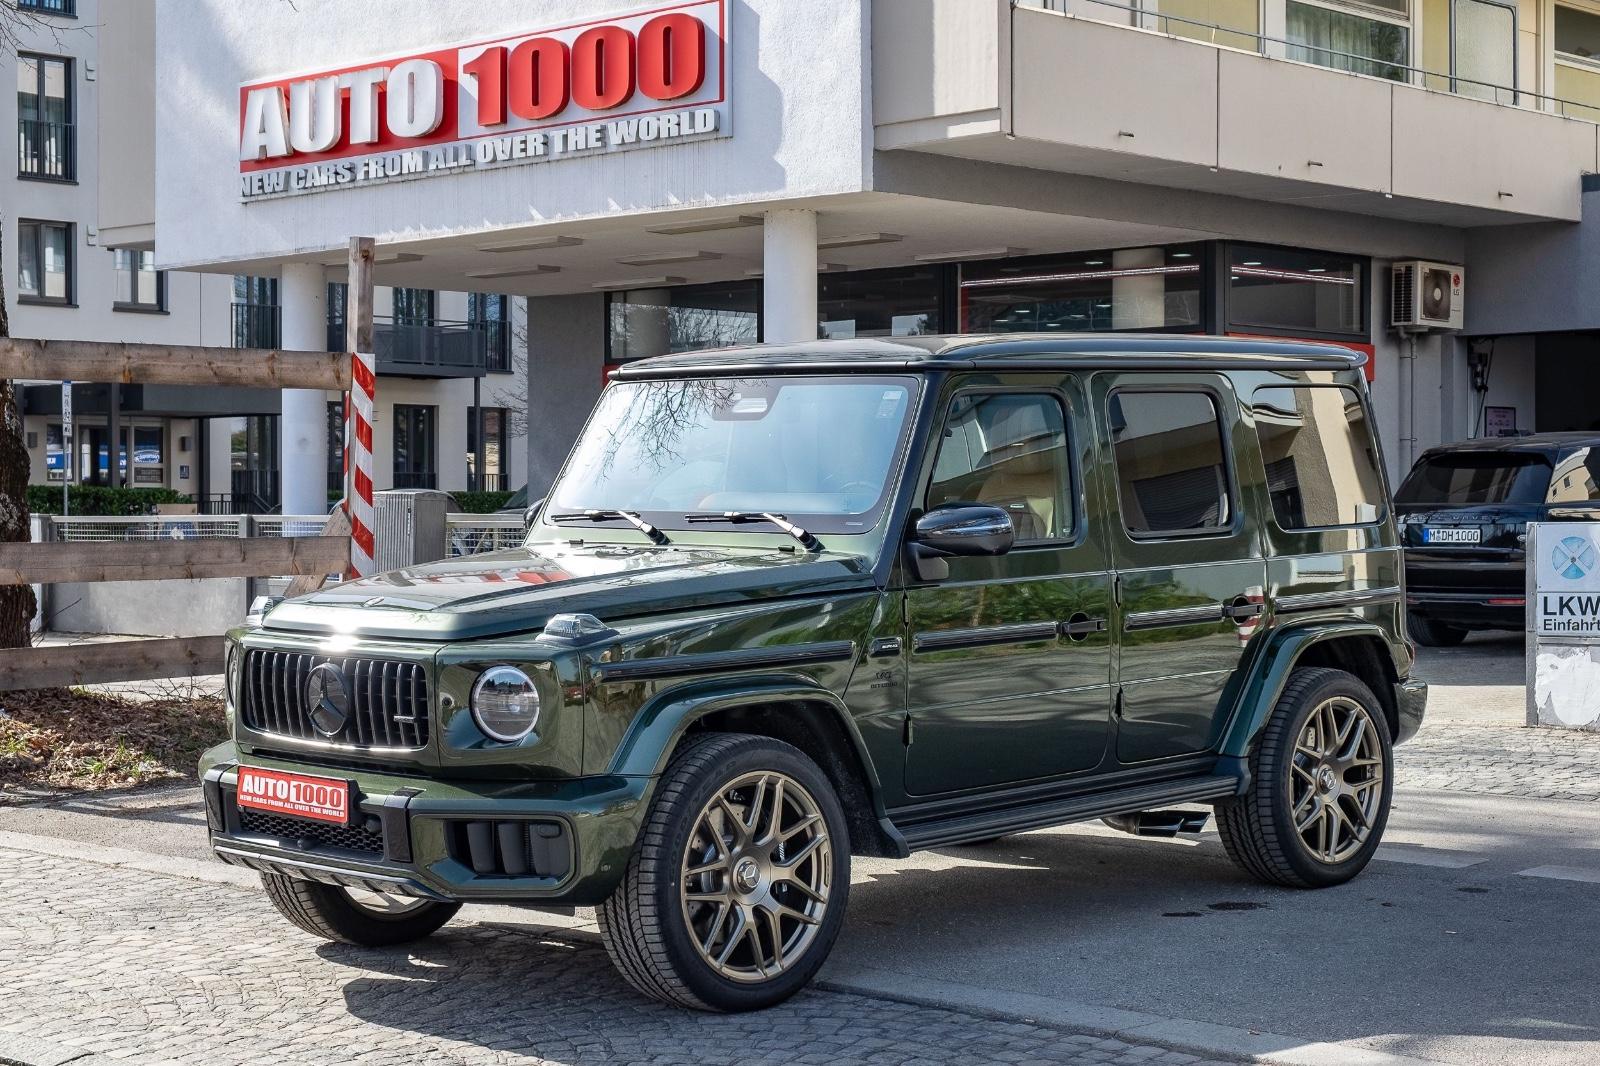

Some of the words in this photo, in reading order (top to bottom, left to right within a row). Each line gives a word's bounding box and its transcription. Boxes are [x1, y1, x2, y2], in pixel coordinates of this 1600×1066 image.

[240, 58, 444, 162] AUTO
[463, 12, 706, 127] 1000
[240, 171, 286, 197] NEW
[290, 162, 355, 190] CARS
[357, 151, 423, 181] FROM
[428, 143, 475, 170] ALL
[476, 133, 545, 163] OVER
[550, 124, 604, 153] THE
[607, 108, 718, 146] WORLD
[1429, 530, 1436, 541] M
[1441, 530, 1454, 541] DH
[1455, 530, 1479, 541] 1000
[1543, 596, 1600, 616] LKW
[1543, 618, 1600, 631] Einfahrt
[242, 774, 289, 800] AUTO
[292, 783, 342, 809] 1000
[240, 794, 253, 802] NEW
[253, 796, 267, 805] CARS
[268, 799, 284, 808] FROM
[284, 802, 294, 810] ALL
[294, 804, 309, 812] OVER
[310, 806, 322, 814] THE
[322, 808, 345, 818] WORLD
